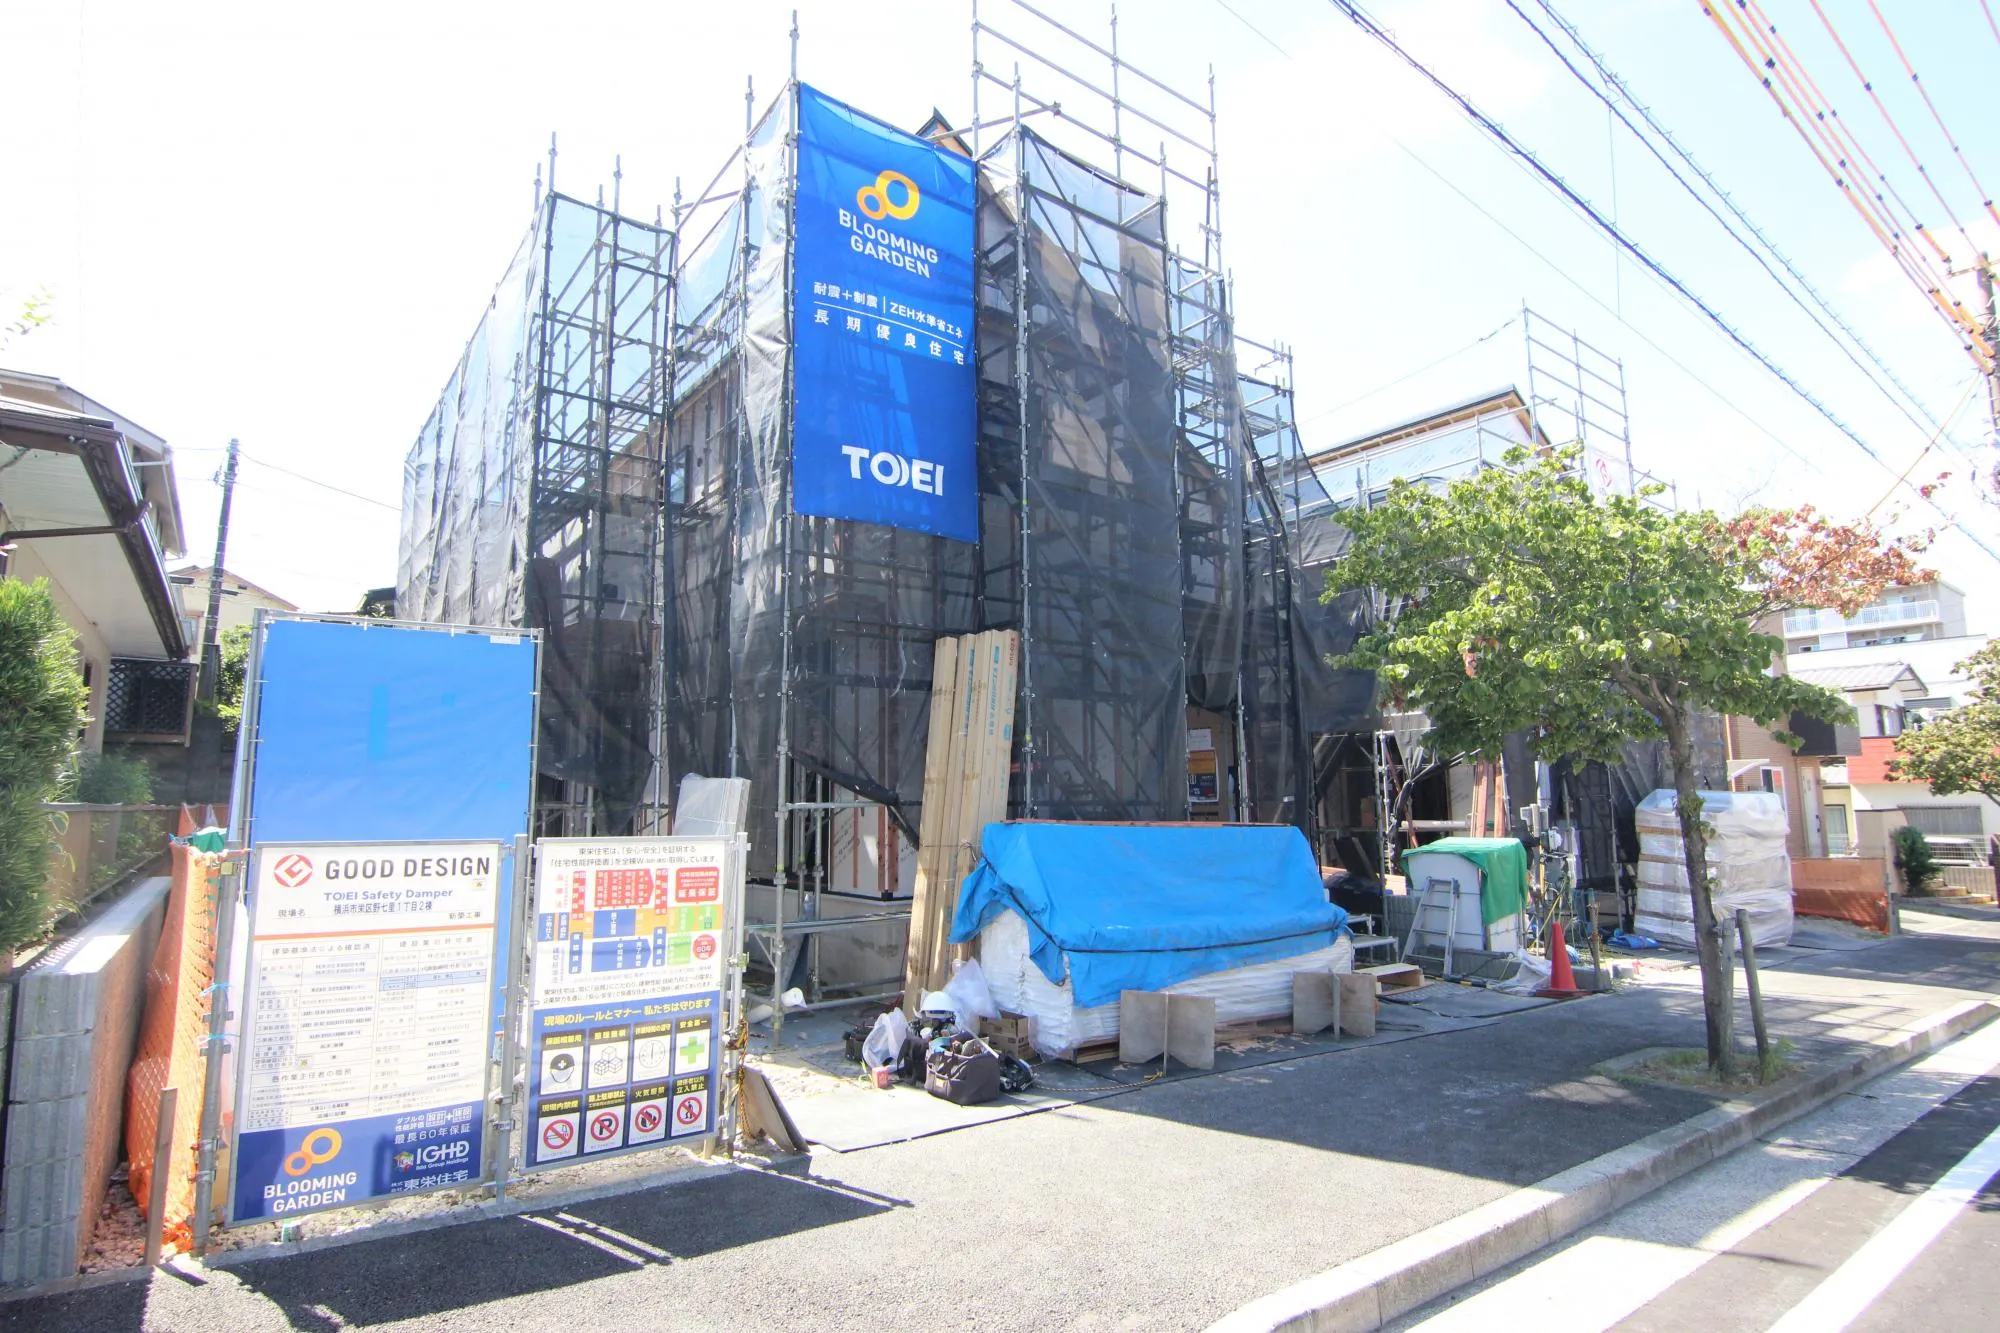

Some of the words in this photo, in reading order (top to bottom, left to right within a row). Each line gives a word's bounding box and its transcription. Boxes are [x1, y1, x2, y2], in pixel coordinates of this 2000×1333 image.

[839, 208, 938, 263] BLOOMING
[850, 234, 930, 278] GARDEN
[814, 309, 964, 366] 長期優良住宅
[326, 859, 394, 880] GOOD
[403, 857, 490, 878] DESIGN
[362, 890, 402, 901] Safety
[406, 889, 453, 899] Damper
[278, 908, 306, 918] 現場名
[544, 1009, 641, 1026] 現場のルールとマナー
[644, 998, 711, 1016] 私たちは守ります
[680, 1019, 708, 1029] 安全第一
[635, 1086, 665, 1098] 火気厳禁
[676, 1083, 704, 1094] 立入禁止
[542, 1100, 579, 1112] 現場内禁煙
[264, 1171, 357, 1199] BLOOMING
[404, 1169, 468, 1191] 東栄住宅
[273, 1189, 346, 1213] GARDEN
